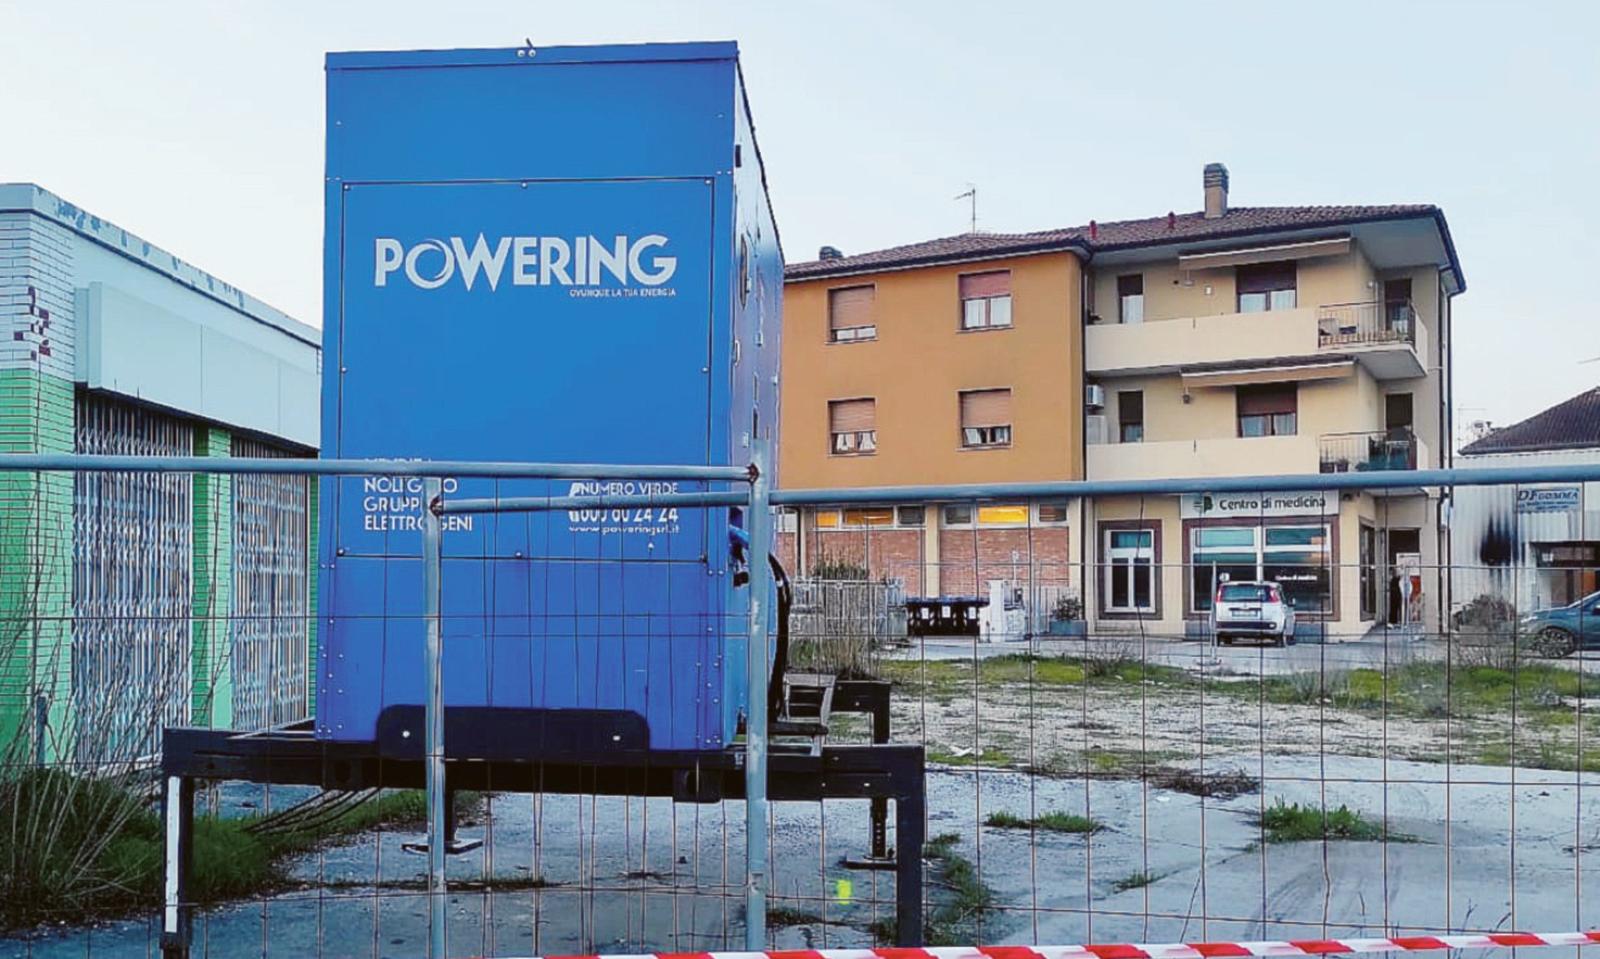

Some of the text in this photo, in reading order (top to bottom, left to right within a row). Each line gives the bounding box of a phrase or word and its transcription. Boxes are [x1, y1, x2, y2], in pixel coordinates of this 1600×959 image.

[374, 232, 677, 292] POWERING
[569, 287, 677, 298] OVUNQUE LA TUA ENERGIA
[364, 477, 458, 493] NOLGO
[580, 482, 635, 495] NUMERO
[1219, 496, 1326, 511] Centro di medicina
